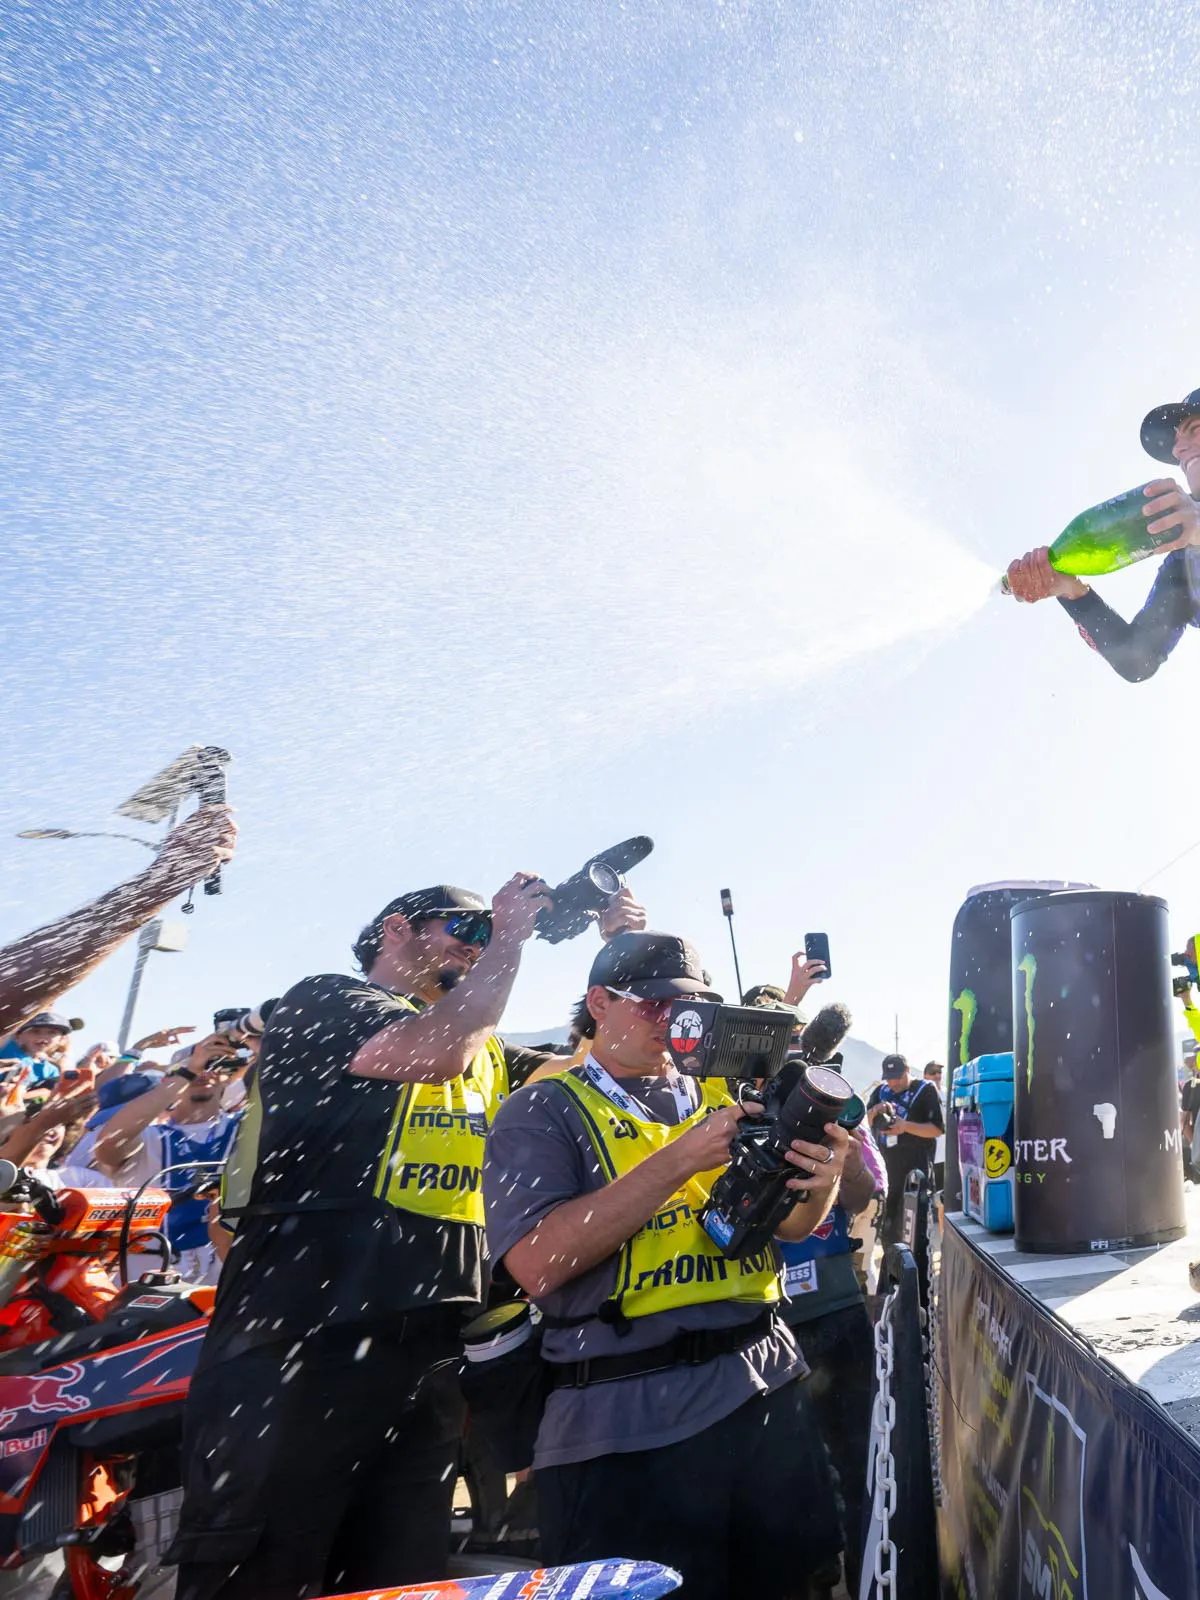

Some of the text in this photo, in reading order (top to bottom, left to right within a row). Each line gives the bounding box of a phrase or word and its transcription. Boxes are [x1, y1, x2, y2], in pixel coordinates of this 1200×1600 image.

[400, 1162, 483, 1192] FRON
[88, 1208, 160, 1220] RENHAL
[634, 1254, 727, 1290] FRONT
[5, 1429, 47, 1456] Bull
